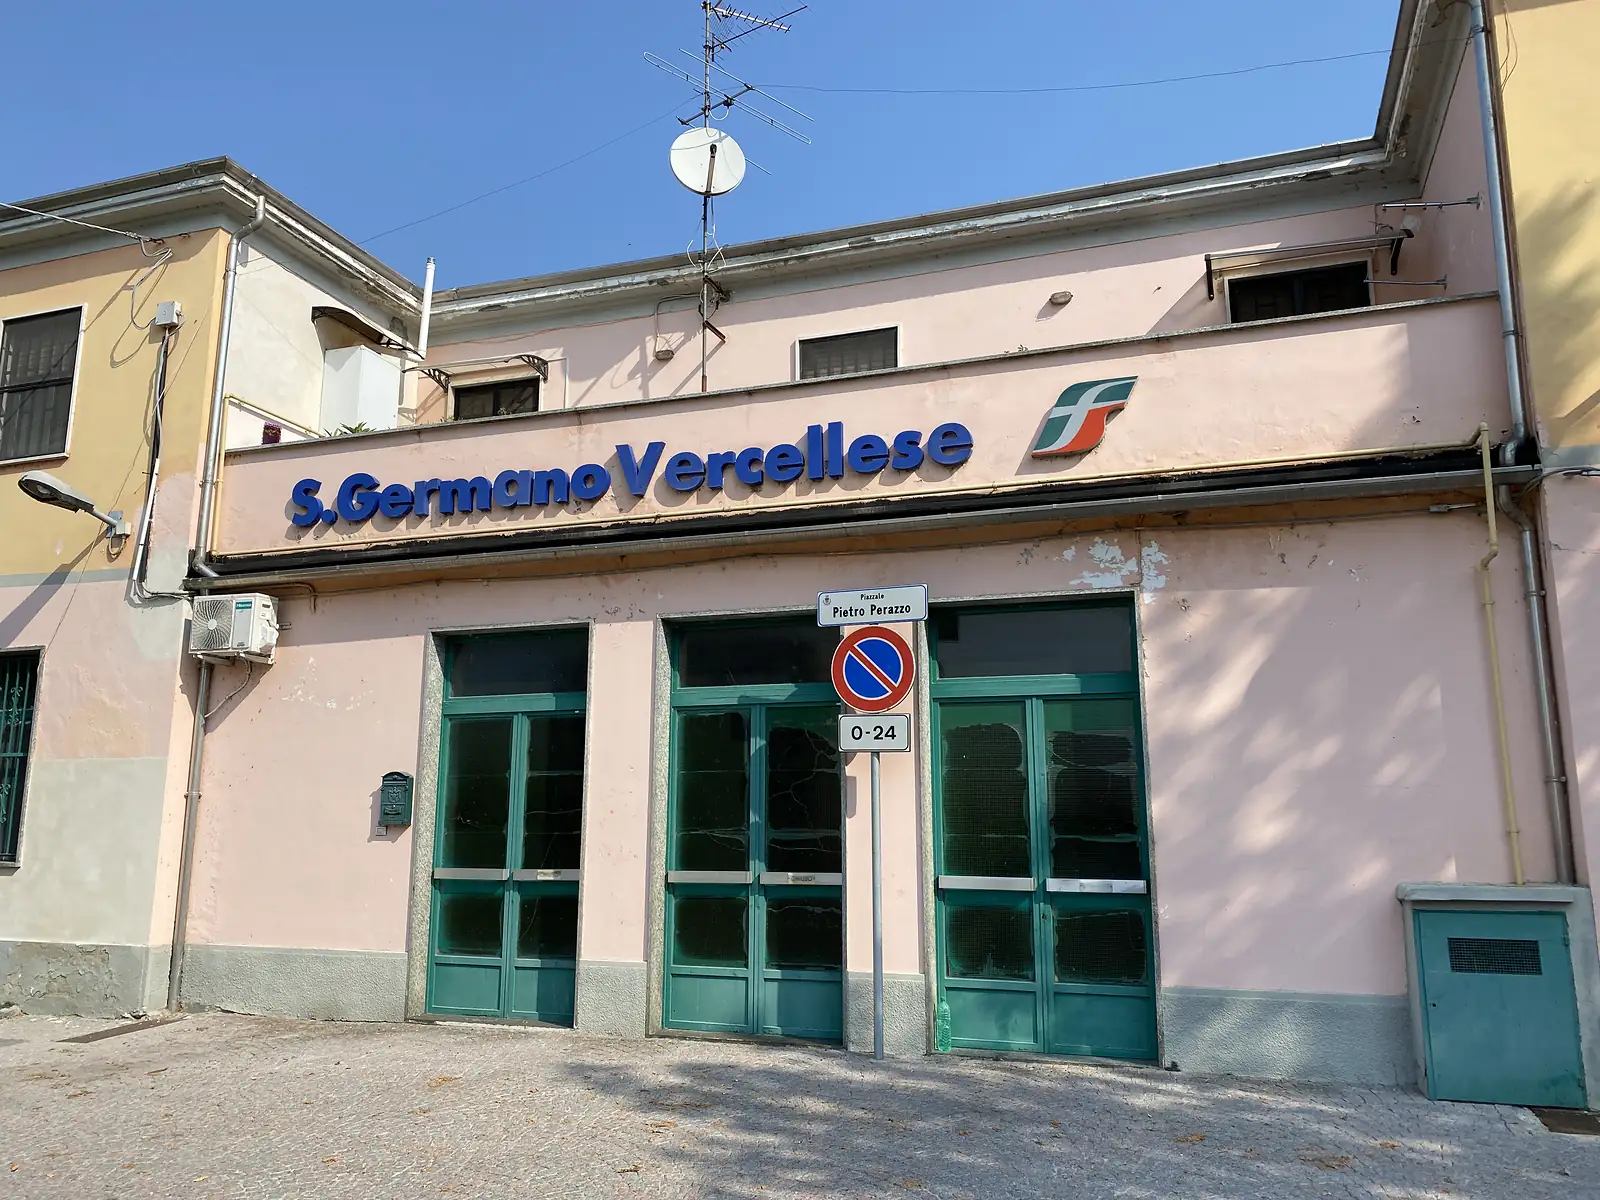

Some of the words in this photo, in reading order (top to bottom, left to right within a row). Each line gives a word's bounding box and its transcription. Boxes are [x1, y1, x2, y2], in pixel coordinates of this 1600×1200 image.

[615, 421, 974, 497] Vercellese
[833, 606, 865, 618] Pietro
[870, 604, 911, 616] Perazzo
[851, 725, 896, 741] 0-24
